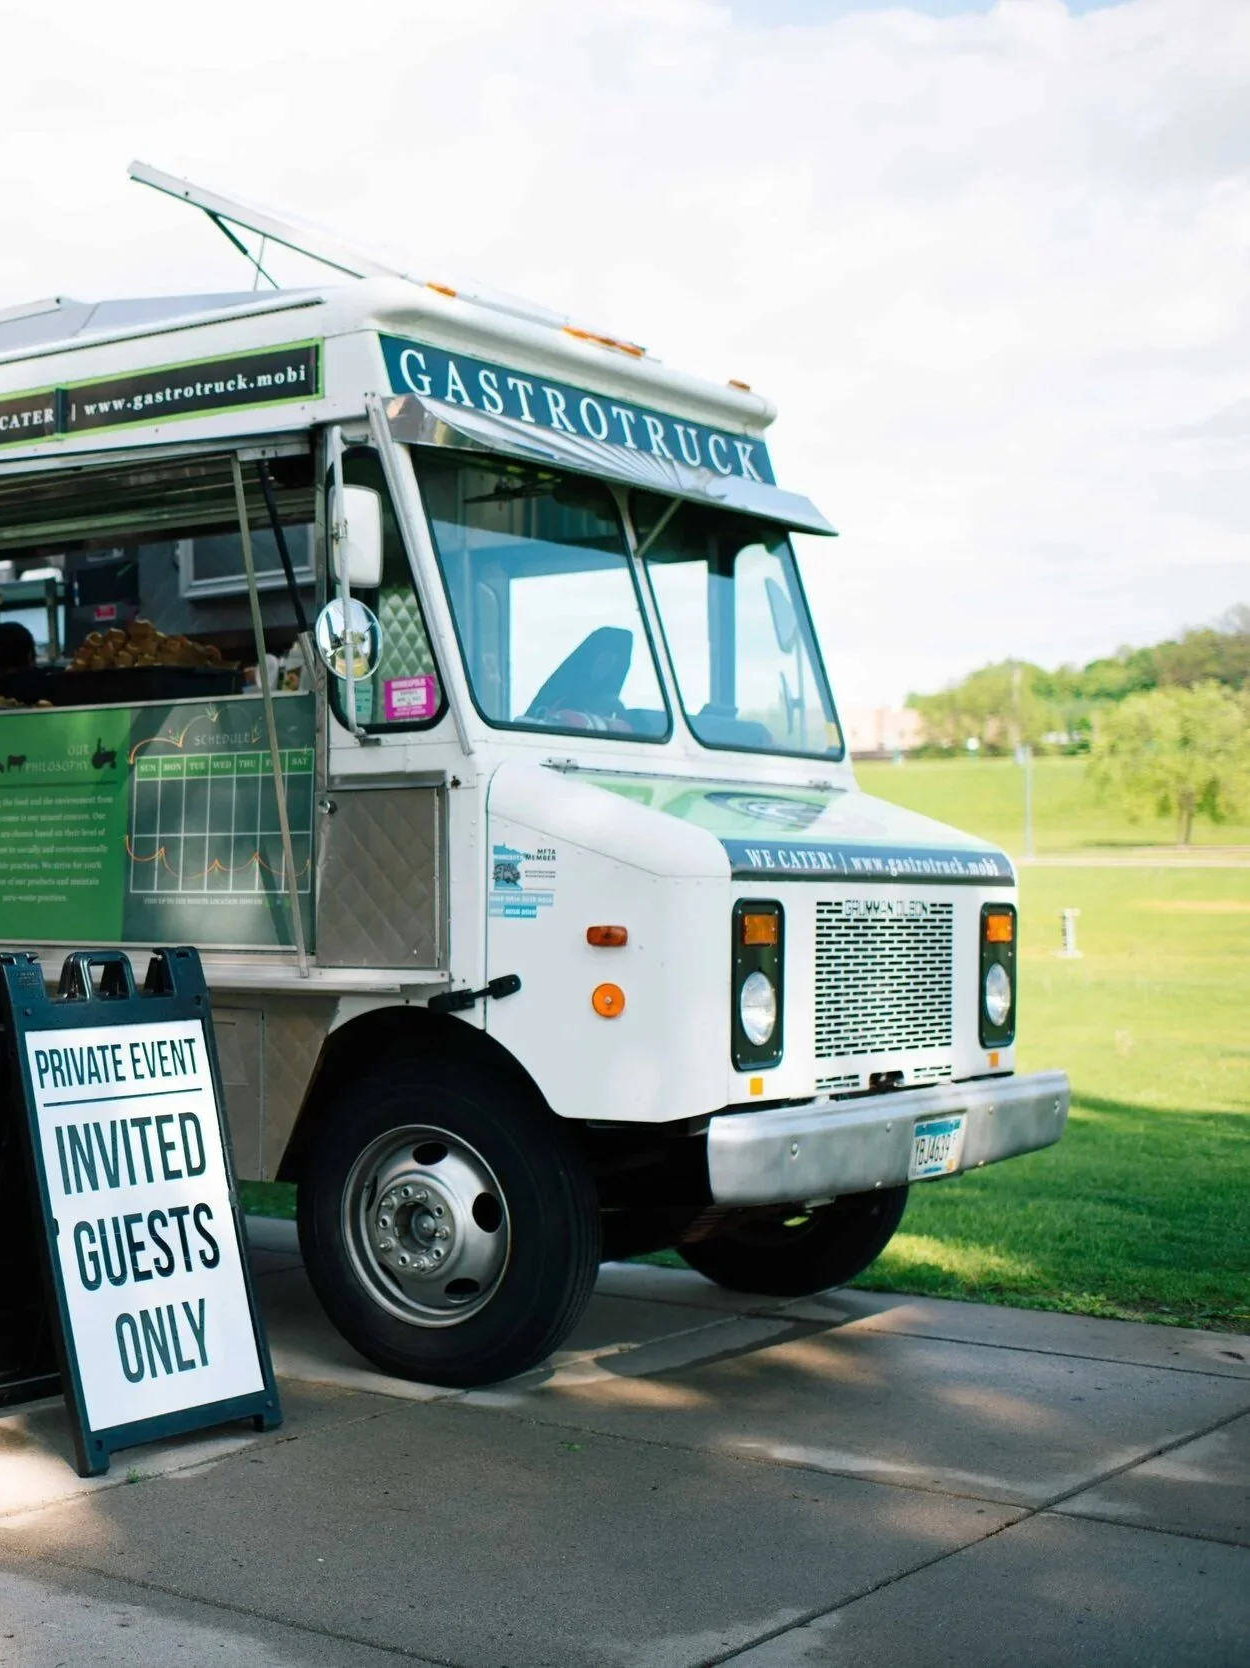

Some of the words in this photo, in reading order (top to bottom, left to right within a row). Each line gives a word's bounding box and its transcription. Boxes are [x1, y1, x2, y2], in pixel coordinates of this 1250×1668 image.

[83, 364, 306, 416] www.gastrotruck.mobi
[399, 348, 764, 483] GASTROTRUCK
[140, 763, 157, 772] SUN
[163, 762, 182, 772] MON
[189, 761, 206, 770] TUE
[213, 760, 232, 769] WED
[238, 759, 257, 768] THU
[291, 757, 308, 766] SAT
[193, 732, 250, 746] SCHEDULE
[745, 849, 775, 868] WE
[778, 849, 837, 870] CATER!
[850, 855, 999, 877] www.gastrotruck.mobi
[34, 1043, 126, 1089] PRIVATE
[129, 1038, 199, 1080] EVENT
[54, 1111, 207, 1195] INVITED
[73, 1202, 221, 1292] GUESTS
[115, 1297, 210, 1384] ONLY
